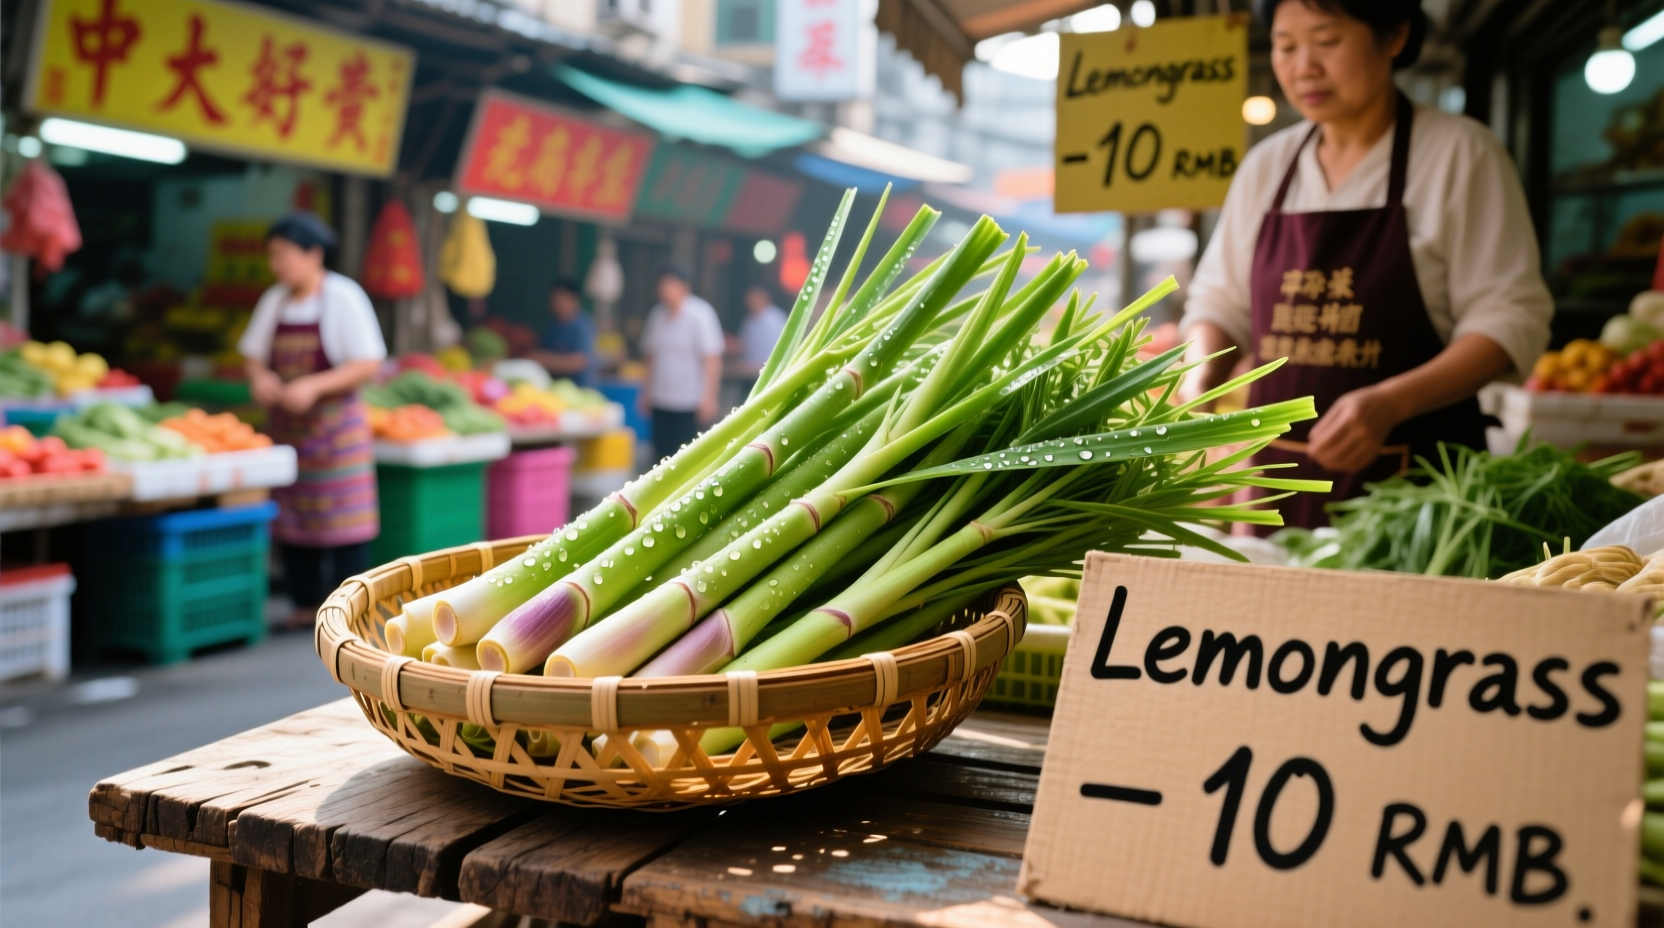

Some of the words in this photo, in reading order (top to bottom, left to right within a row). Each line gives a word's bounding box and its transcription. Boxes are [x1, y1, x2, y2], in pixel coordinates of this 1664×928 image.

[1065, 51, 1237, 105] Lemongrass
[1171, 146, 1238, 180] RMB
[1090, 585, 1623, 747] Lemongrass
